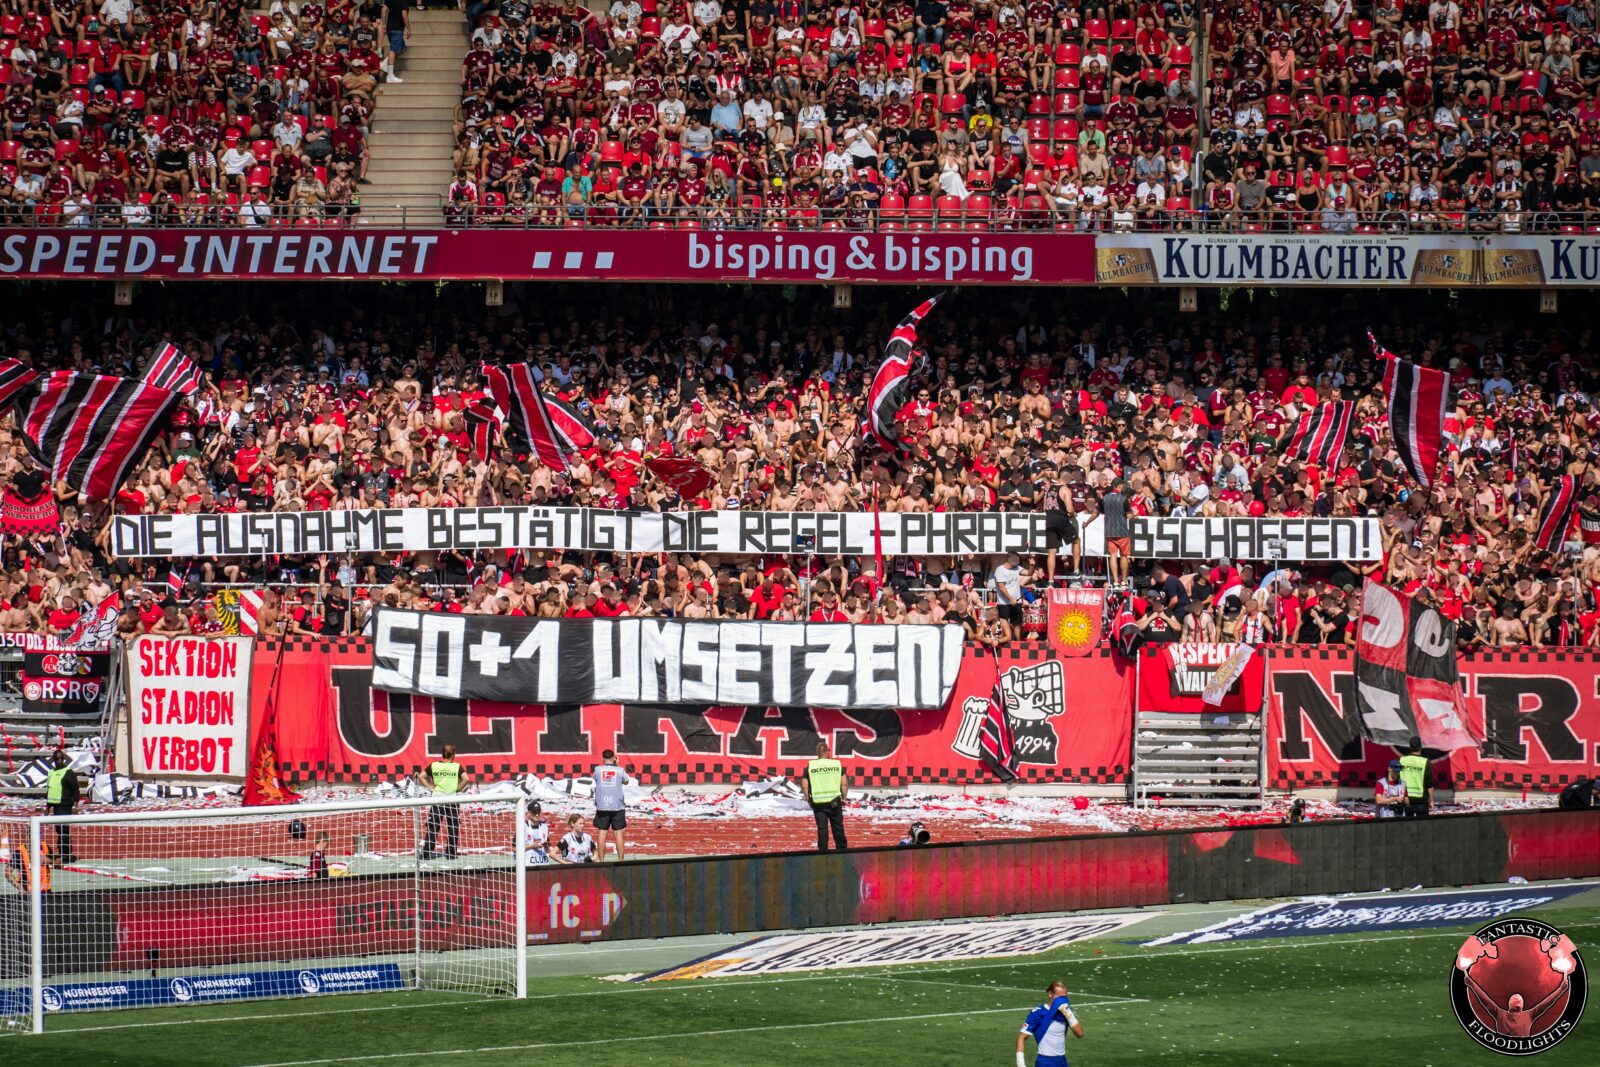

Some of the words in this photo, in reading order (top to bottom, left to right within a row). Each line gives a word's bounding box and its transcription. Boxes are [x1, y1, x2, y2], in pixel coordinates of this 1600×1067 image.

[0, 235, 438, 273] SPEED-INTERNET
[688, 233, 836, 279] bisping
[846, 236, 876, 270] &
[885, 235, 1034, 280] bisping
[1163, 238, 1407, 279] KULMBACHER
[1096, 263, 1151, 282] KULMBACHER
[1417, 263, 1473, 282] KULMBACHER
[1483, 263, 1539, 282] KULMBACHER
[115, 514, 172, 555] DIE
[196, 510, 403, 554] AUSNAHME
[427, 507, 641, 551] BESTÄTIGT
[662, 511, 718, 551] DIE
[1104, 517, 1370, 559] BSCHAFFEN!
[139, 638, 237, 678] SEKTION
[372, 608, 560, 703] 50+1
[593, 617, 966, 709] UMSETZEN!
[42, 680, 81, 699] RSR
[141, 687, 233, 726] STADION
[142, 736, 233, 774] VERBOT
[1014, 735, 1051, 754] 1994
[193, 977, 252, 990] NÜRNBERGER
[320, 969, 379, 983] NÜRNBERGER
[63, 985, 129, 999] NÜRNBERGER
